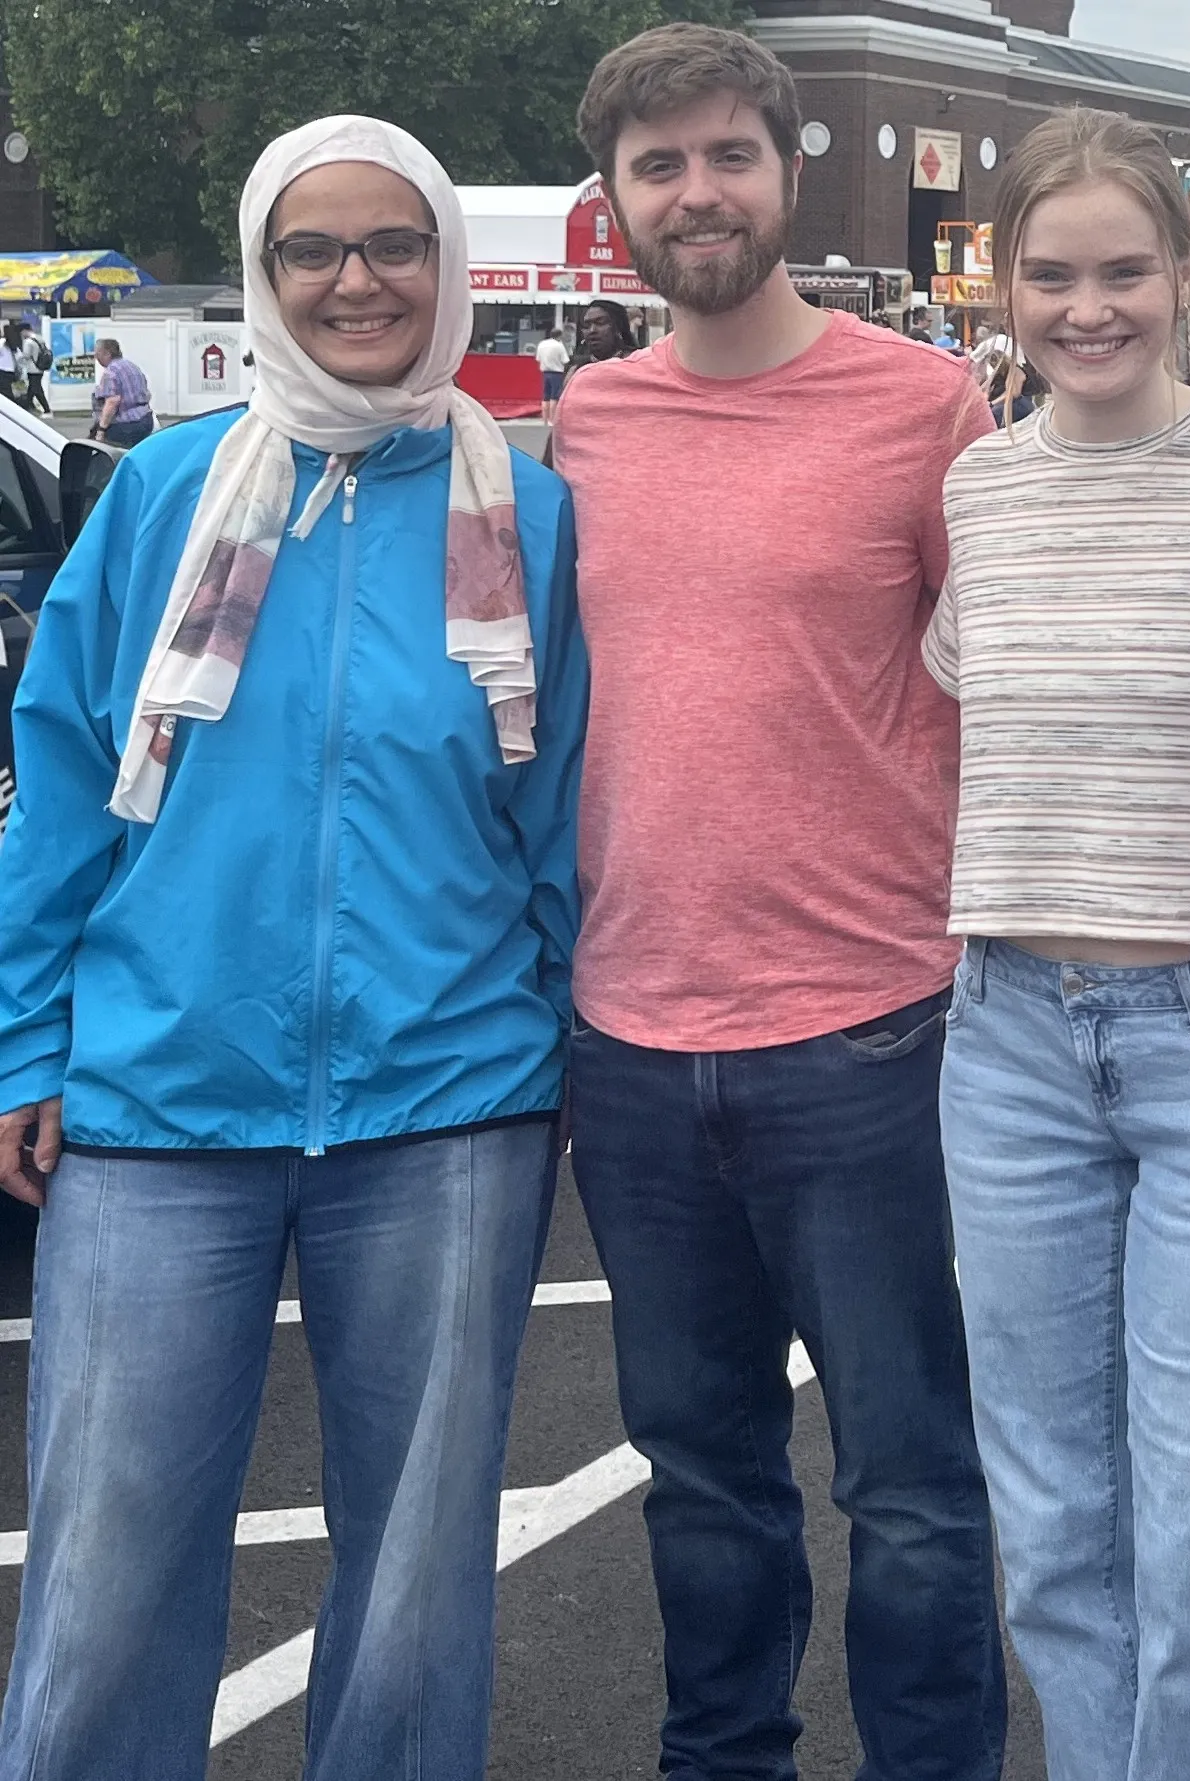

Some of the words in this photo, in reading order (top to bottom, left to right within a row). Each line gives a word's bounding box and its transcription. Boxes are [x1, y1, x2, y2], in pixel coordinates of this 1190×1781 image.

[590, 247, 613, 260] EARS
[494, 274, 525, 287] EARS
[602, 277, 641, 290] ELEPHANT
